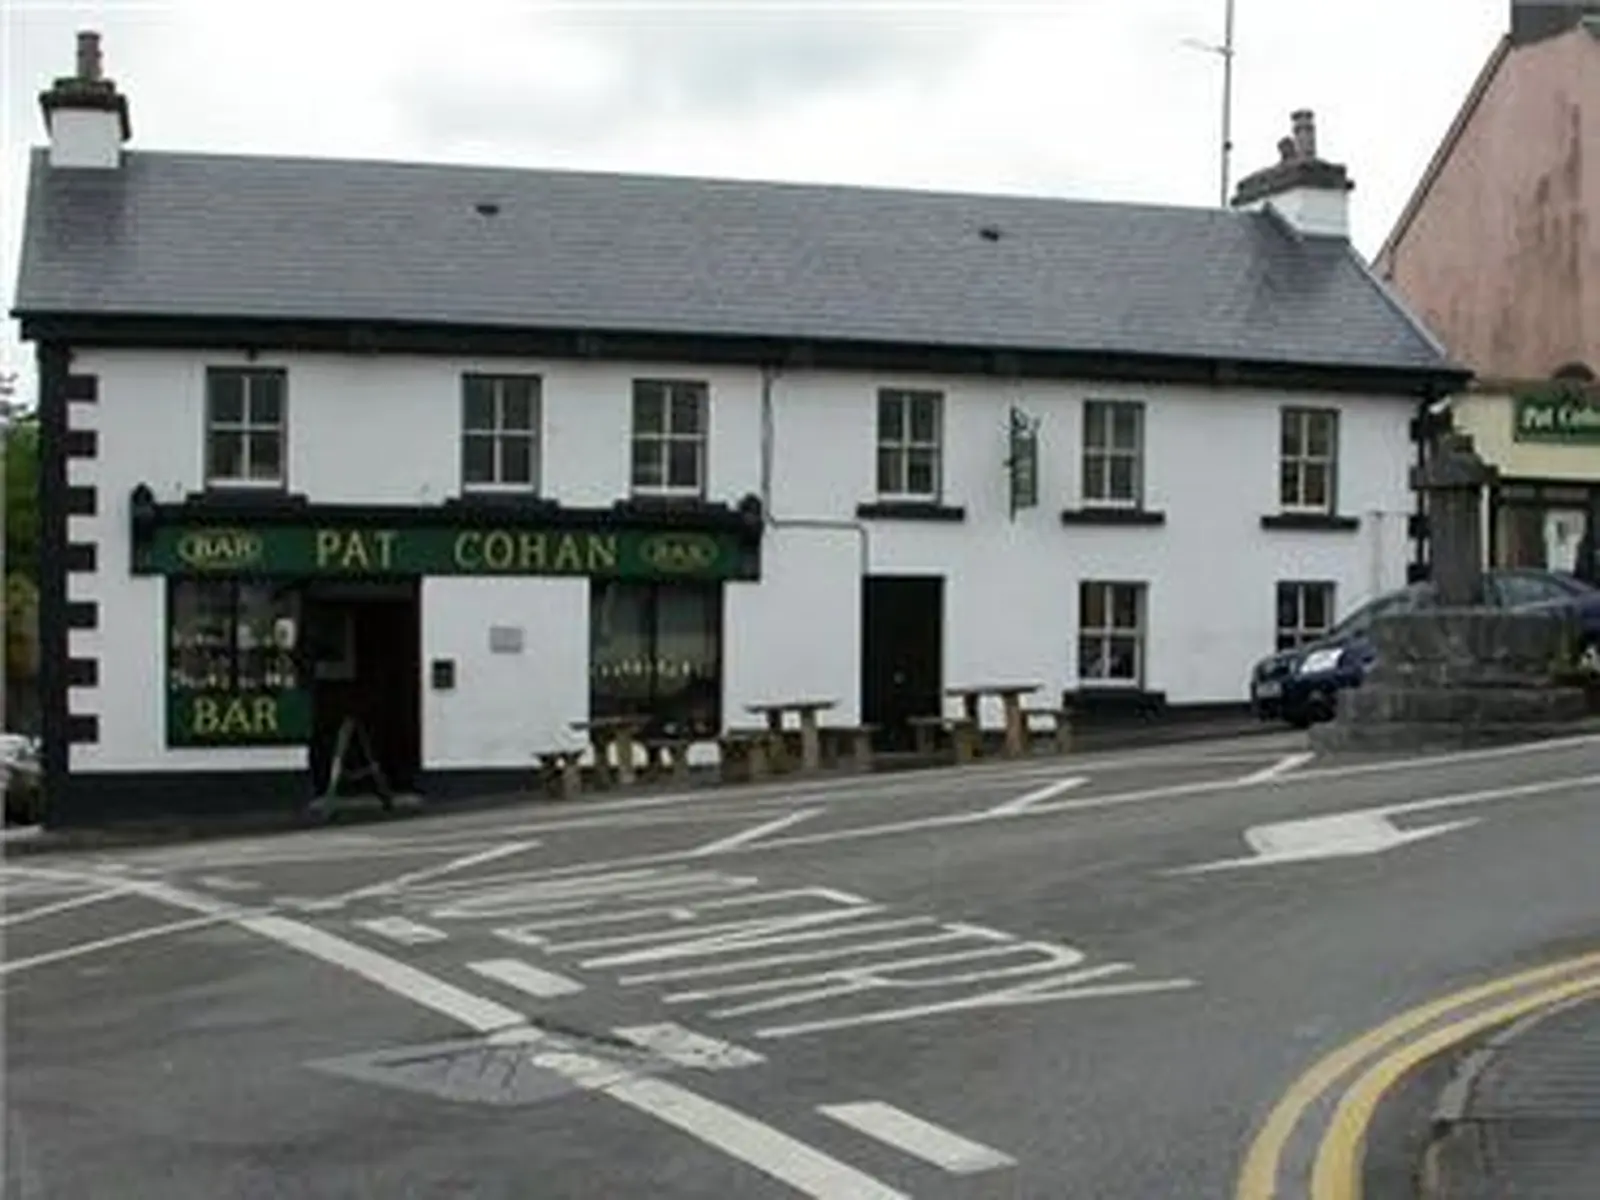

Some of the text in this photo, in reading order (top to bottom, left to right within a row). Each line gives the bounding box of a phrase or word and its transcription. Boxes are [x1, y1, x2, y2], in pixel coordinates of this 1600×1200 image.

[315, 528, 617, 571] PAT COHAN
[193, 697, 277, 734] BAR
[490, 885, 1197, 1038] ENTRY
